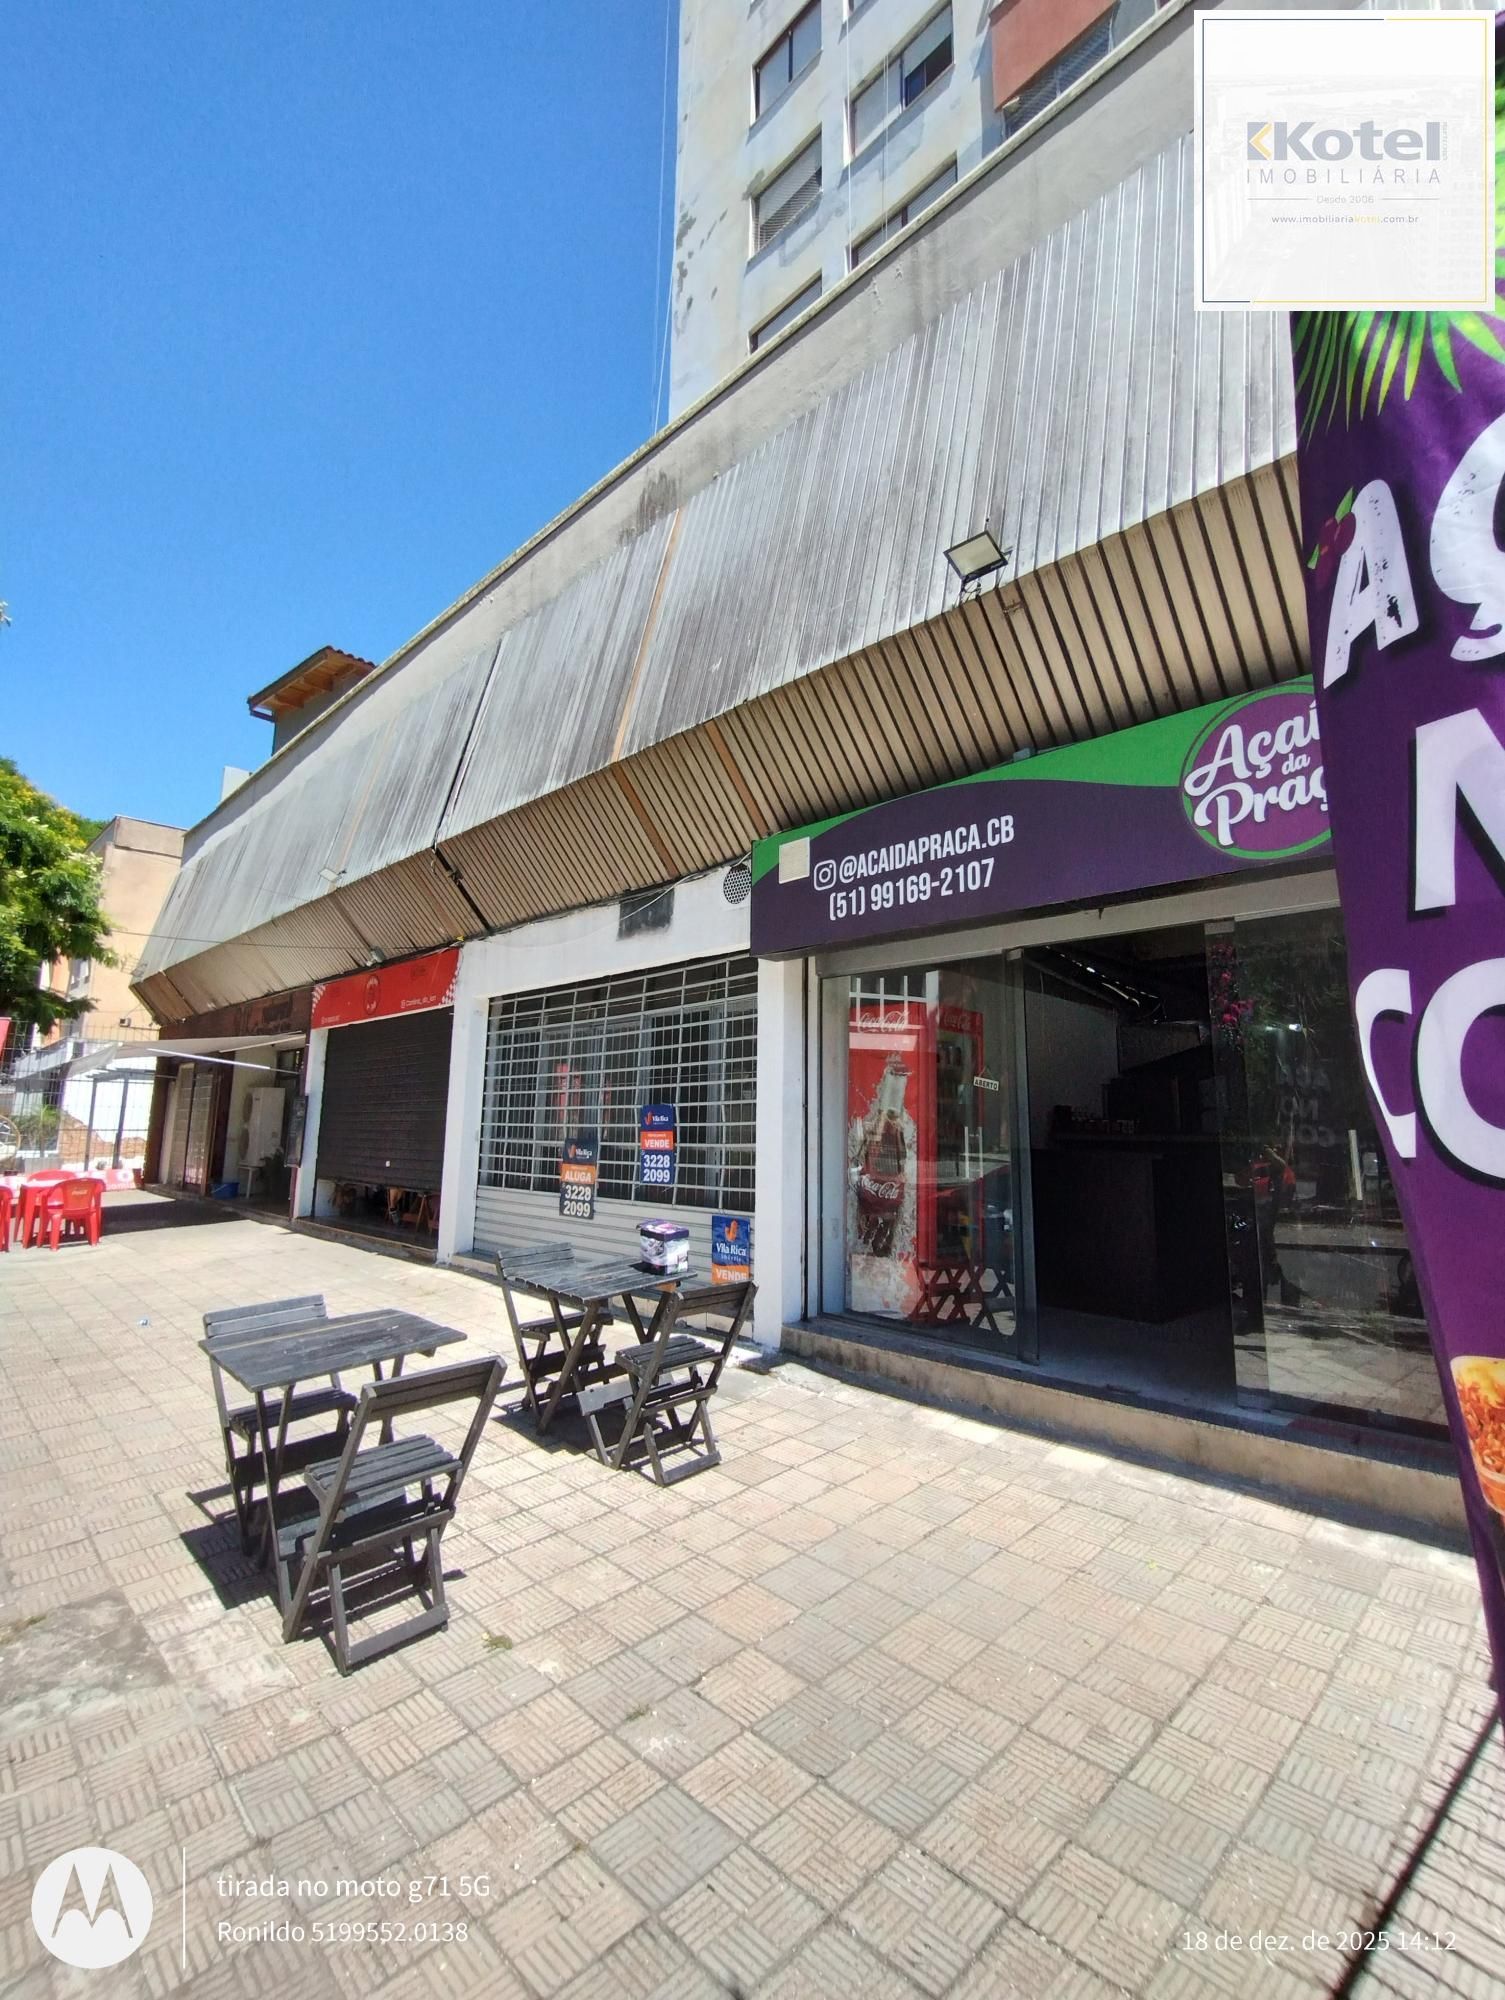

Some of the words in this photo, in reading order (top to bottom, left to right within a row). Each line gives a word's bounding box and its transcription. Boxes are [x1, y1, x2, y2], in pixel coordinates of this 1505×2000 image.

[1281, 753, 1311, 775] da
[837, 814, 1015, 886] @ACAIDAPRACA.CB
[828, 888, 866, 921] (51)
[870, 857, 996, 912] 99169-2107
[974, 1078, 999, 1091] ABERTO
[644, 1139, 670, 1148] VENDE
[643, 1154, 671, 1168] 3228
[564, 1170, 592, 1182] ALUGA
[643, 1169, 671, 1182] 2099
[564, 1184, 592, 1202] 3228
[563, 1200, 591, 1217] 2099
[716, 1242, 730, 1254] Vila
[730, 1245, 747, 1257] Rica
[715, 1268, 748, 1281] VENDE
